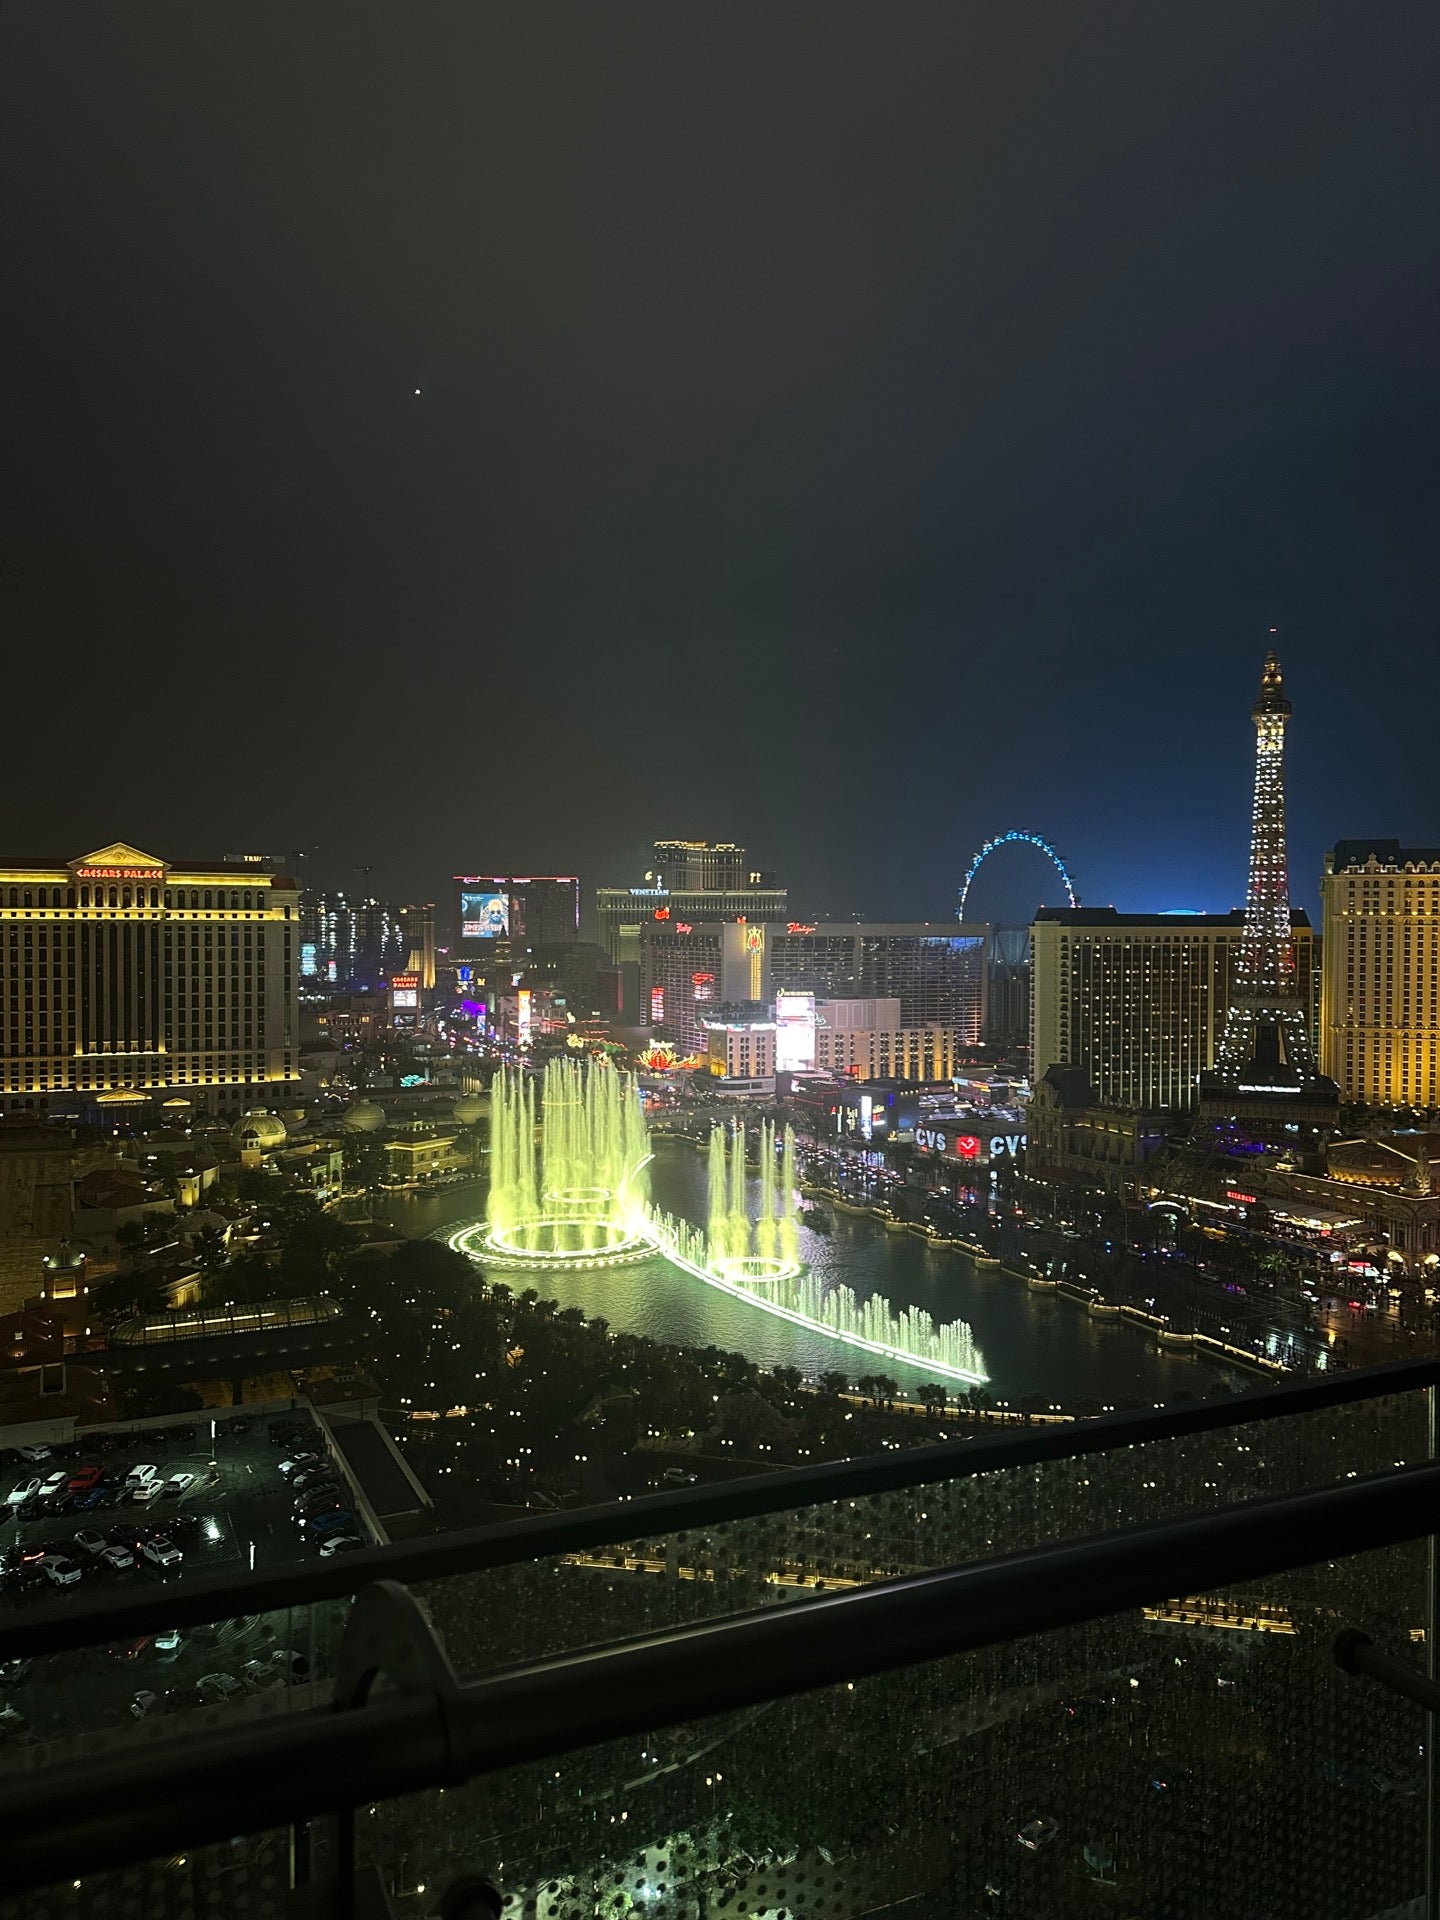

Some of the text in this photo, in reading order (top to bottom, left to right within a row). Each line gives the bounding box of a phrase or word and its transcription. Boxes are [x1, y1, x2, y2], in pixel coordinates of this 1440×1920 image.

[76, 869, 163, 879] CAESARS PALACE
[629, 888, 670, 896] VENETIAN
[916, 1128, 946, 1151] CVS
